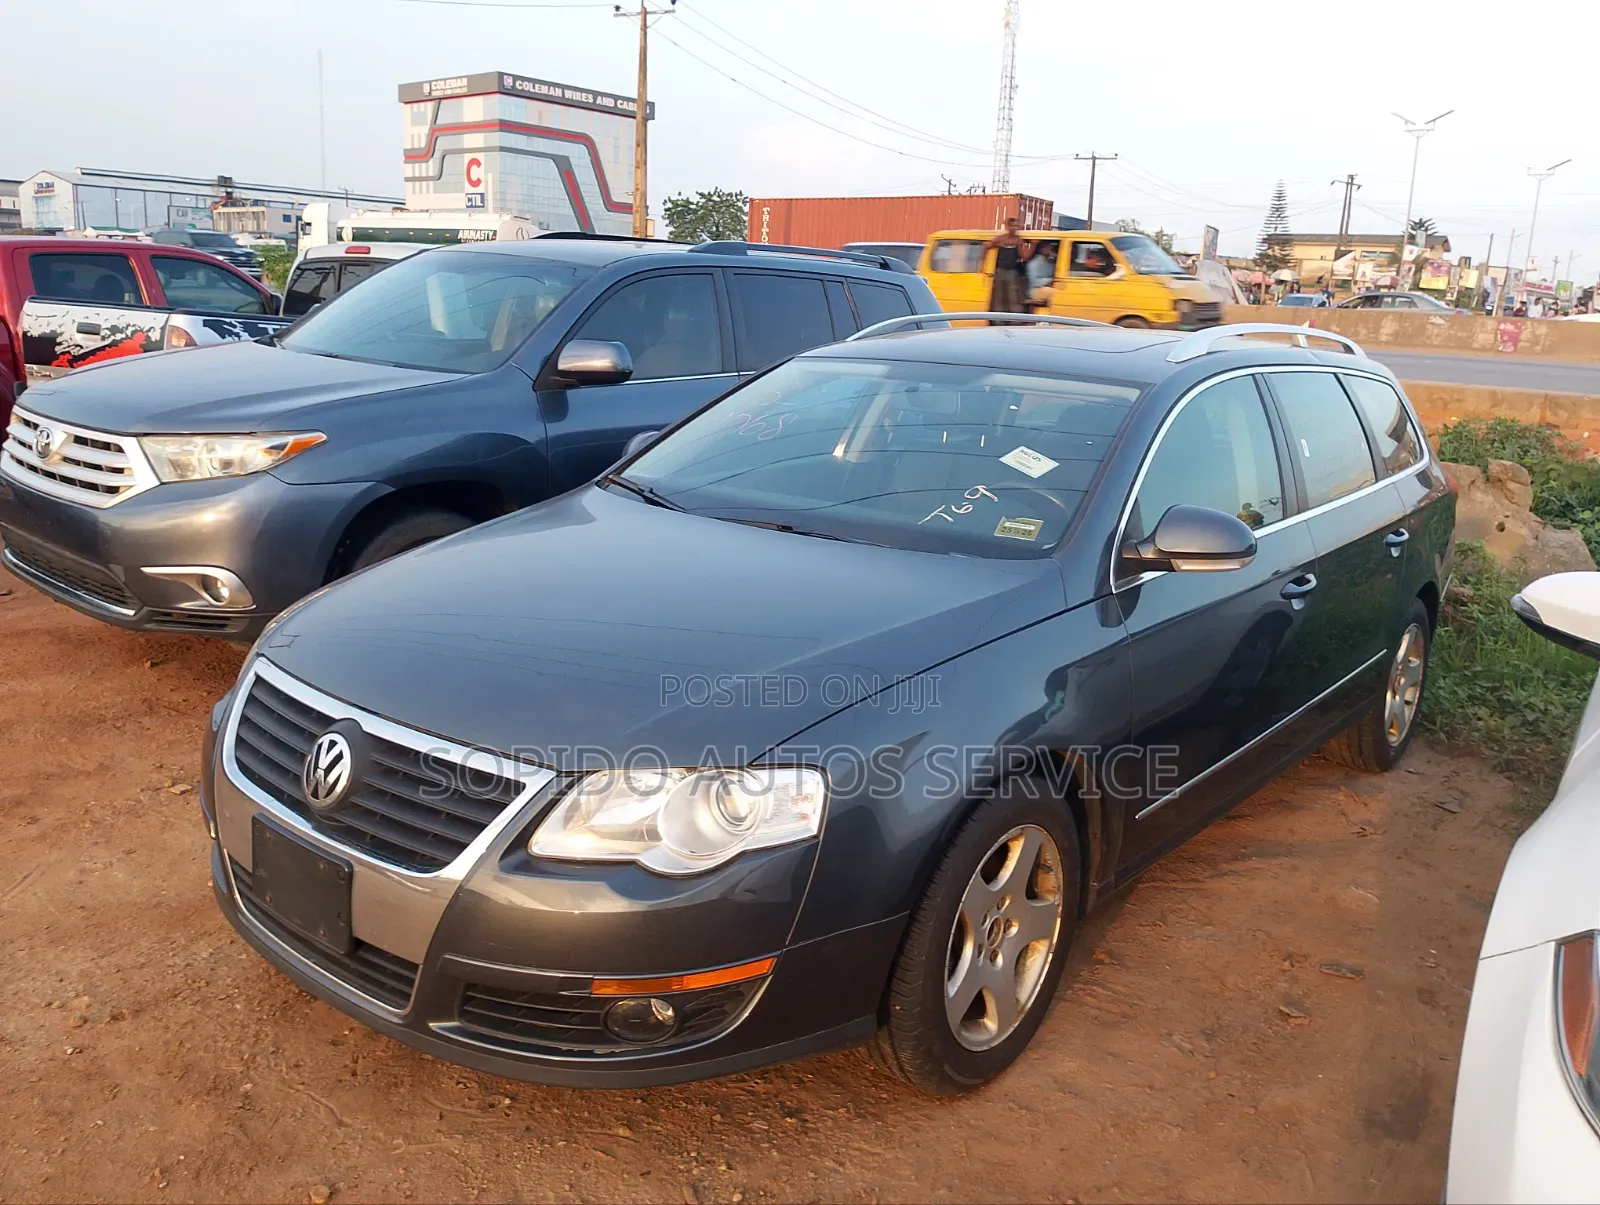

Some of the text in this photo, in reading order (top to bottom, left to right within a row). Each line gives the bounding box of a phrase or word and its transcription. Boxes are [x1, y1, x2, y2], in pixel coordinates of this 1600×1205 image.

[431, 78, 468, 90] COLEMAN
[515, 80, 563, 98] COLEMAN
[564, 88, 594, 104] WIRES
[596, 95, 616, 107] AND
[466, 158, 482, 188] C
[761, 207, 770, 244] TRITO
